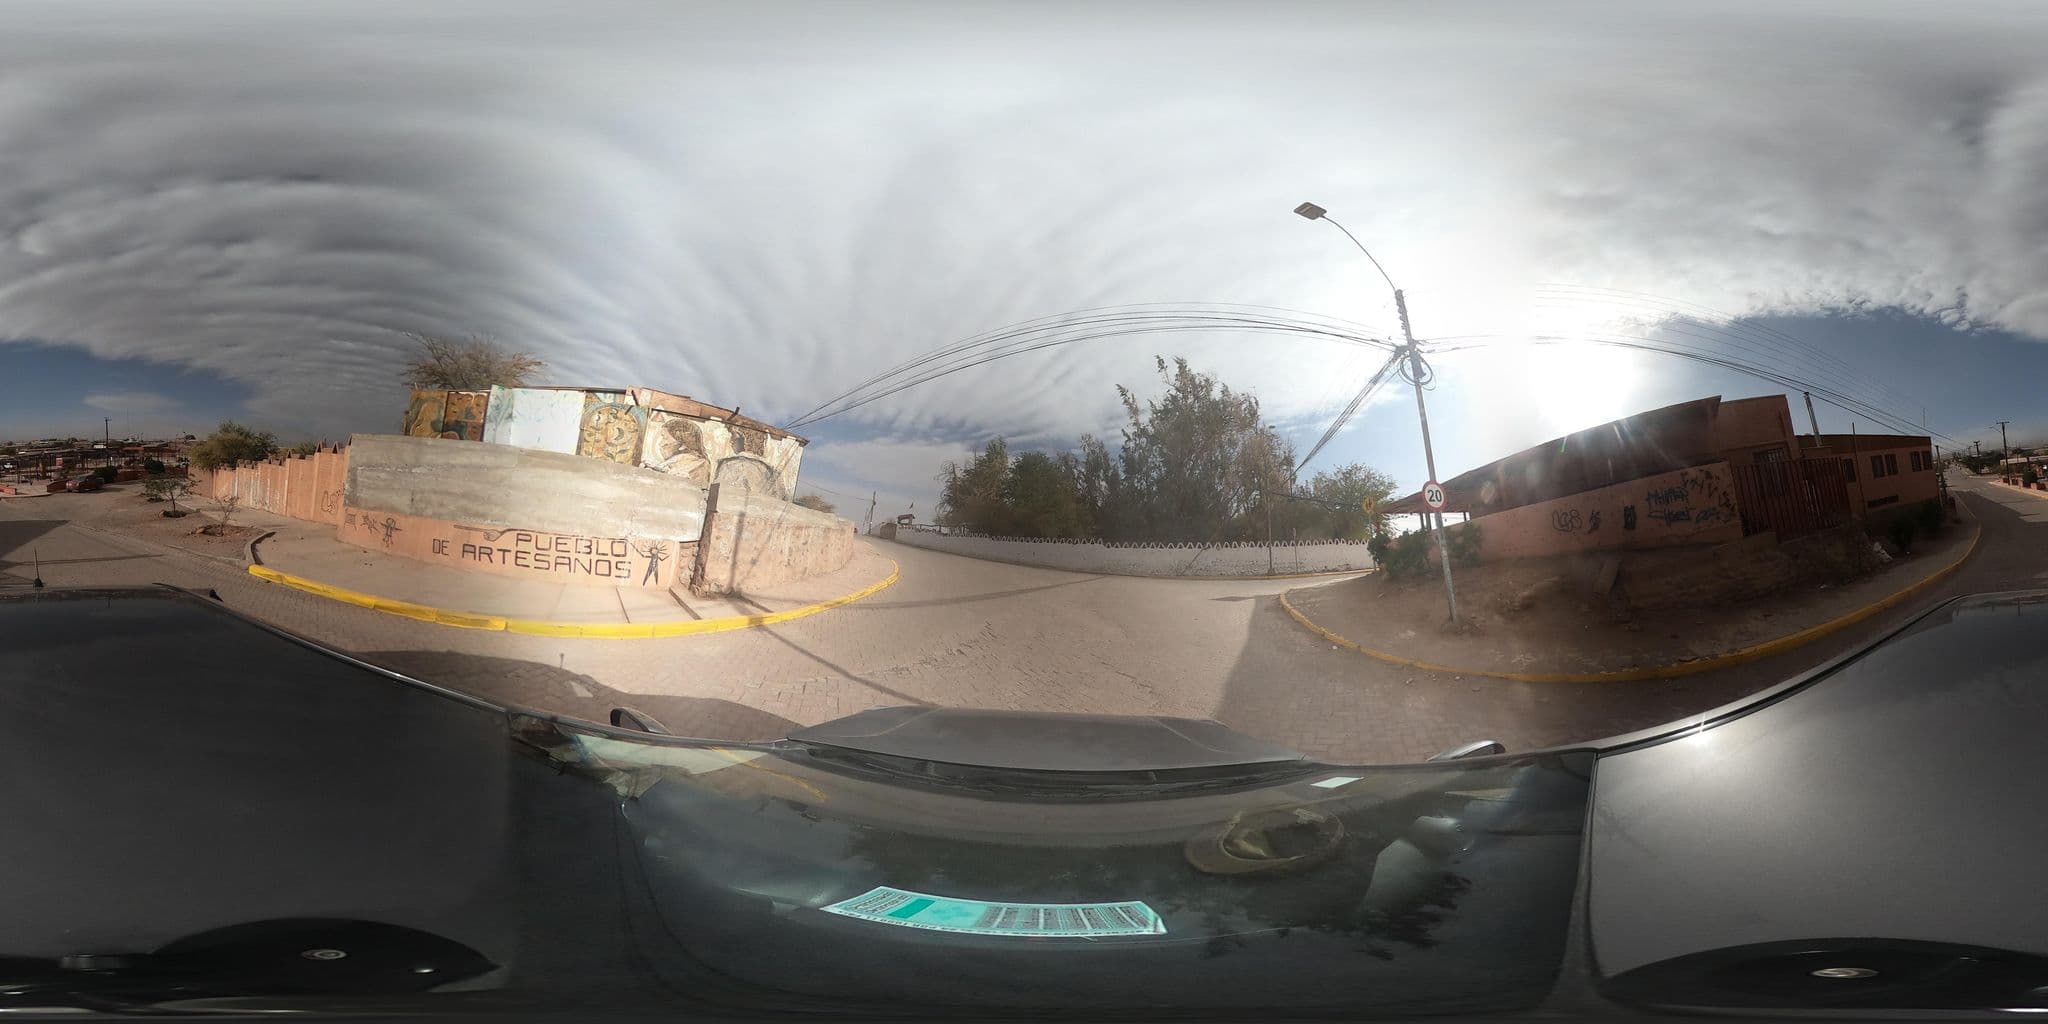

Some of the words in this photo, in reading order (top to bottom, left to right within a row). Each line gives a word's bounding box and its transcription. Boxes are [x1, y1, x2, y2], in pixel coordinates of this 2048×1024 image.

[1427, 489, 1442, 502] 20
[515, 532, 628, 557] PUEBLO
[432, 538, 450, 556] DE
[461, 543, 631, 579] ARTESANOS
